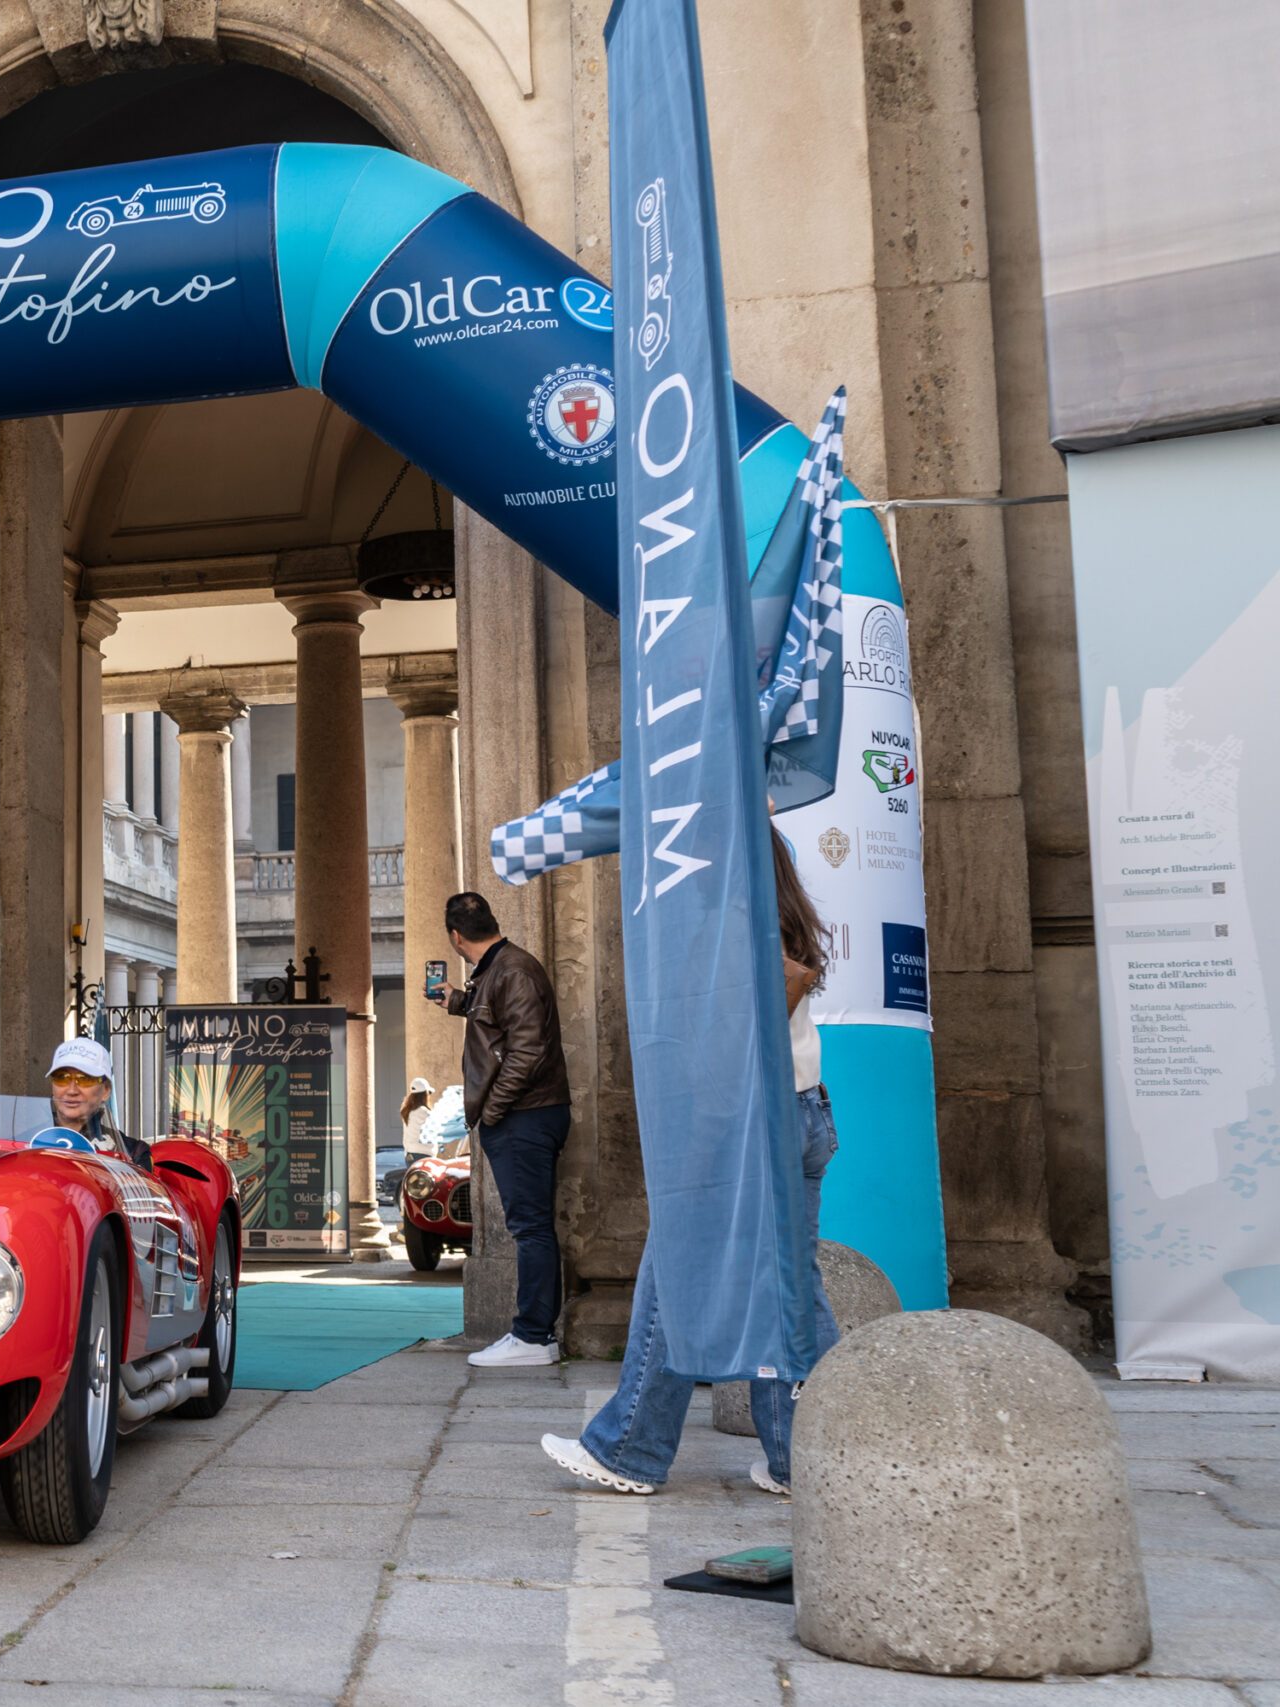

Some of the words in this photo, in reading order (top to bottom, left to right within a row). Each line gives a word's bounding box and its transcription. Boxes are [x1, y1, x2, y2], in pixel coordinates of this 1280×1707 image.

[414, 318, 559, 348] www.oldcar24.com
[534, 371, 598, 426] AUTOMOBILE
[558, 439, 609, 457] MILANO
[504, 485, 586, 507] AUTOMOBILE
[870, 647, 901, 667] PORTO
[871, 730, 911, 751] NUVOLAR
[888, 797, 909, 814] 5260
[1160, 813, 1182, 821] cura
[1185, 811, 1195, 820] di
[866, 831, 898, 842] HOTEL
[867, 844, 907, 858] PRINCIPE
[867, 858, 905, 871] MILANO
[1121, 866, 1161, 877] Concept
[1171, 862, 1236, 873] Illustrazioni:
[1123, 886, 1170, 897] Alessandro
[1171, 885, 1203, 895] Grande
[1128, 960, 1164, 969] Ricerca
[1167, 959, 1200, 968] storica
[1211, 958, 1233, 967] testi
[1136, 972, 1159, 980] cura
[1226, 968, 1236, 977] di
[1129, 982, 1154, 990] Stato
[1156, 981, 1167, 990] di
[1169, 981, 1207, 990] Milano:
[180, 1014, 286, 1038] MILANO
[221, 1034, 334, 1062] Portofino
